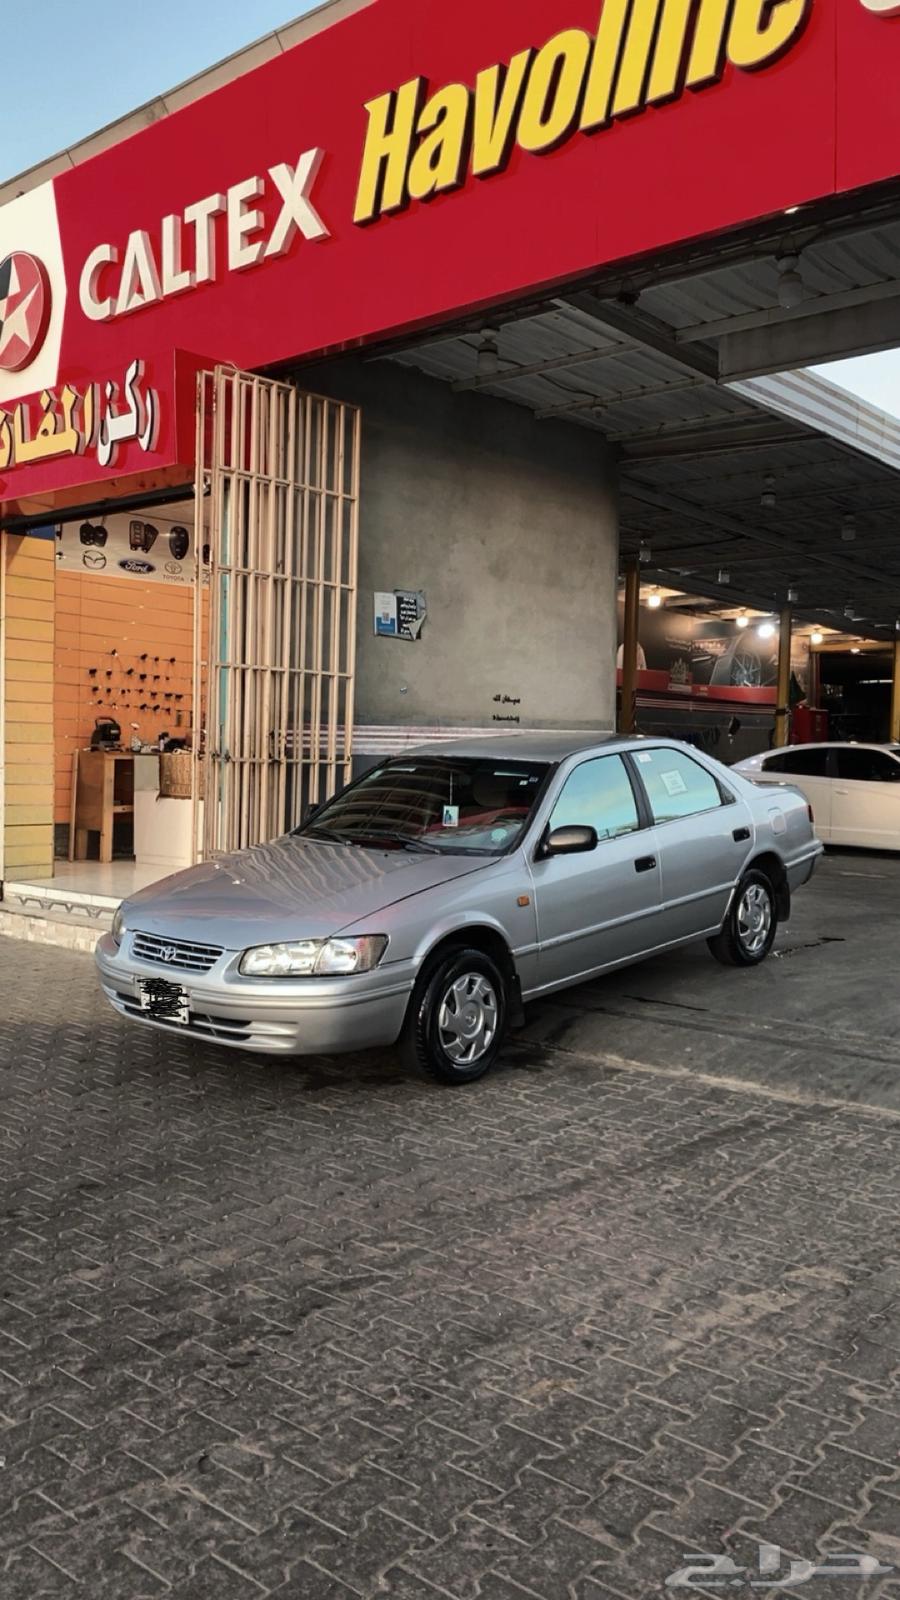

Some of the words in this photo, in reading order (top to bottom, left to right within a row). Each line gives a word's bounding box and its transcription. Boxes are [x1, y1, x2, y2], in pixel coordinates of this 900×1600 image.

[79, 147, 331, 322] CALTEX
[97, 359, 158, 466] ركن
[163, 574, 185, 582] TOYOTA
